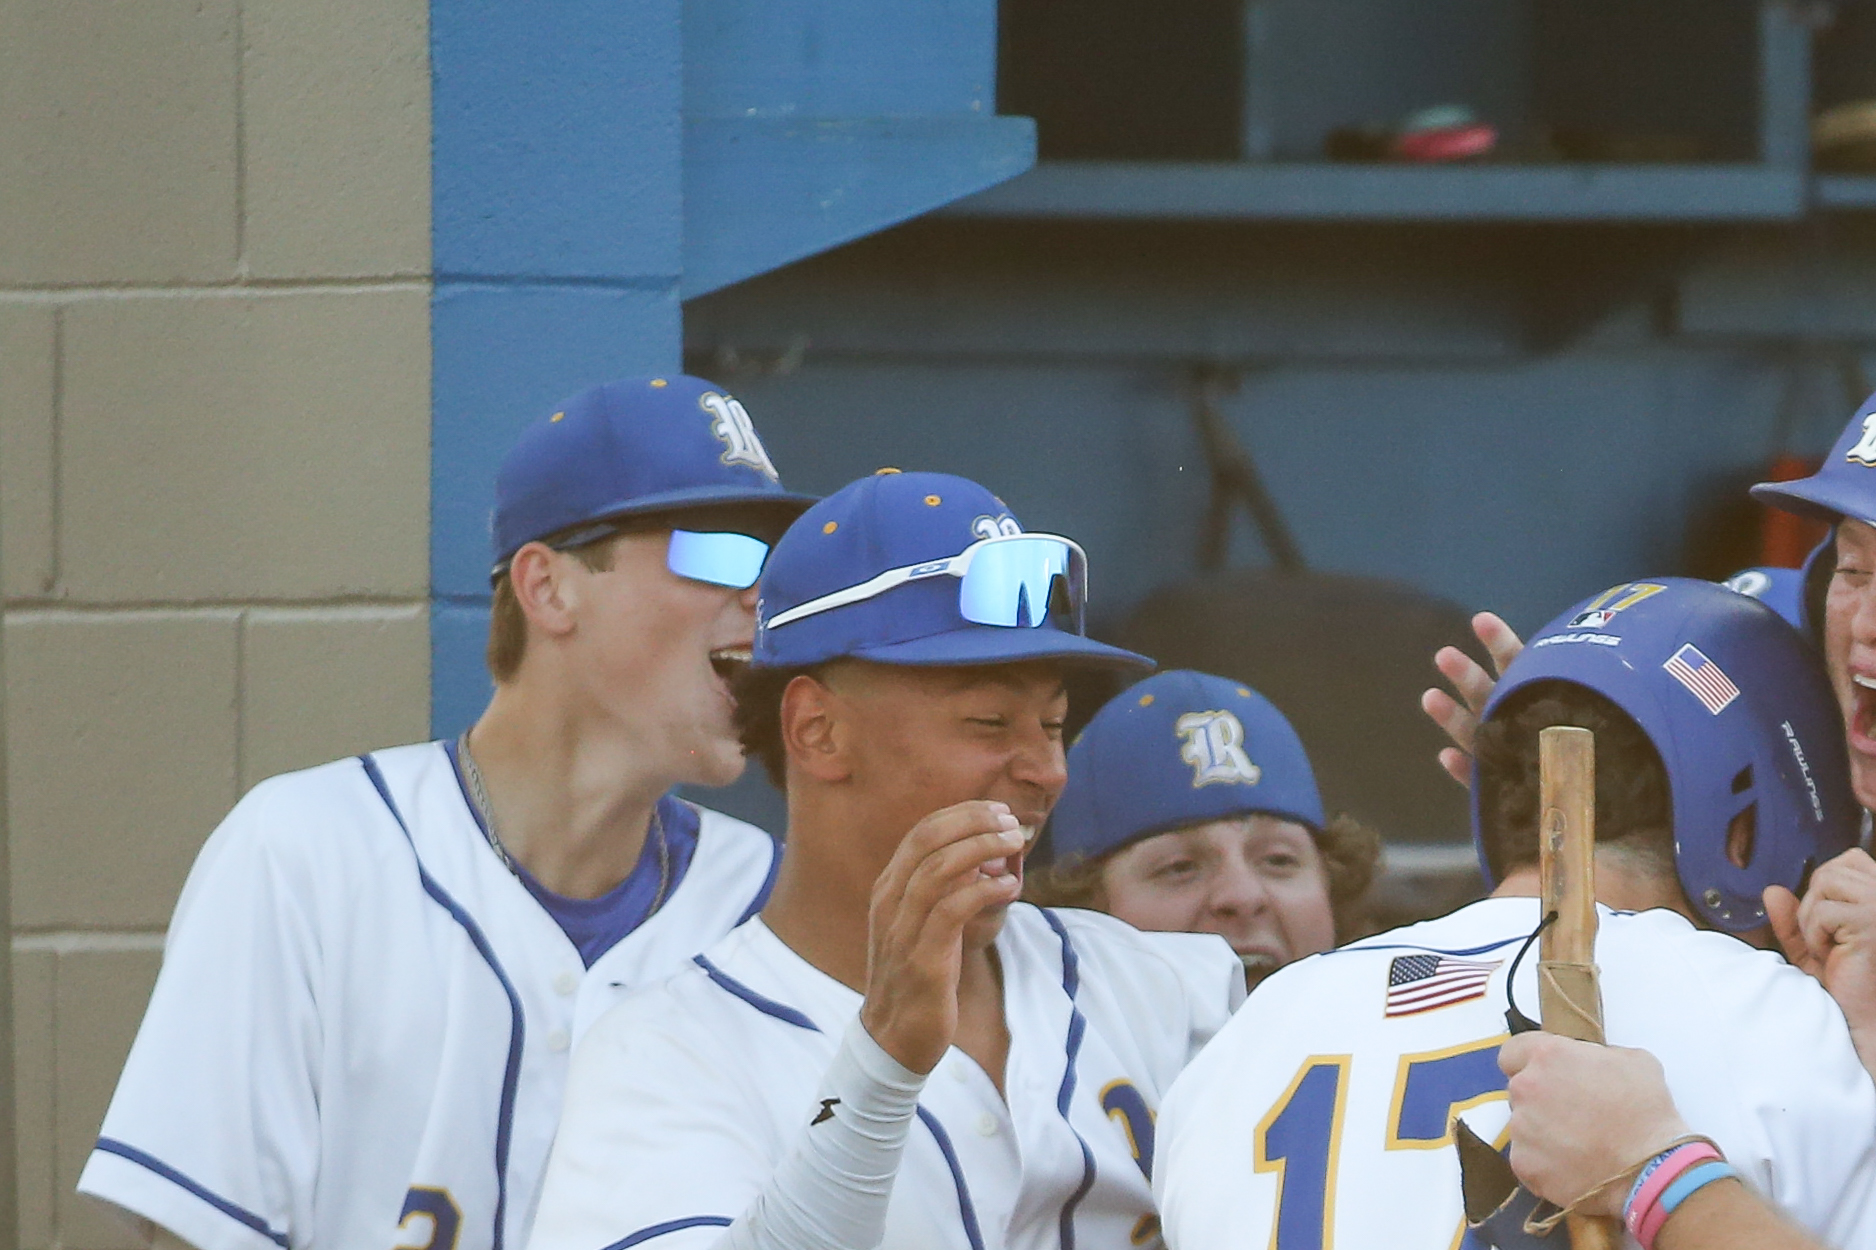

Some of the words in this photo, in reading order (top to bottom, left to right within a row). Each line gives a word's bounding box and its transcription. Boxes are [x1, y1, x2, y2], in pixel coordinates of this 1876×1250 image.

[699, 390, 780, 484] R
[1585, 582, 1669, 612] 17
[1173, 708, 1262, 790] R
[1780, 719, 1826, 823] RAWLINGS
